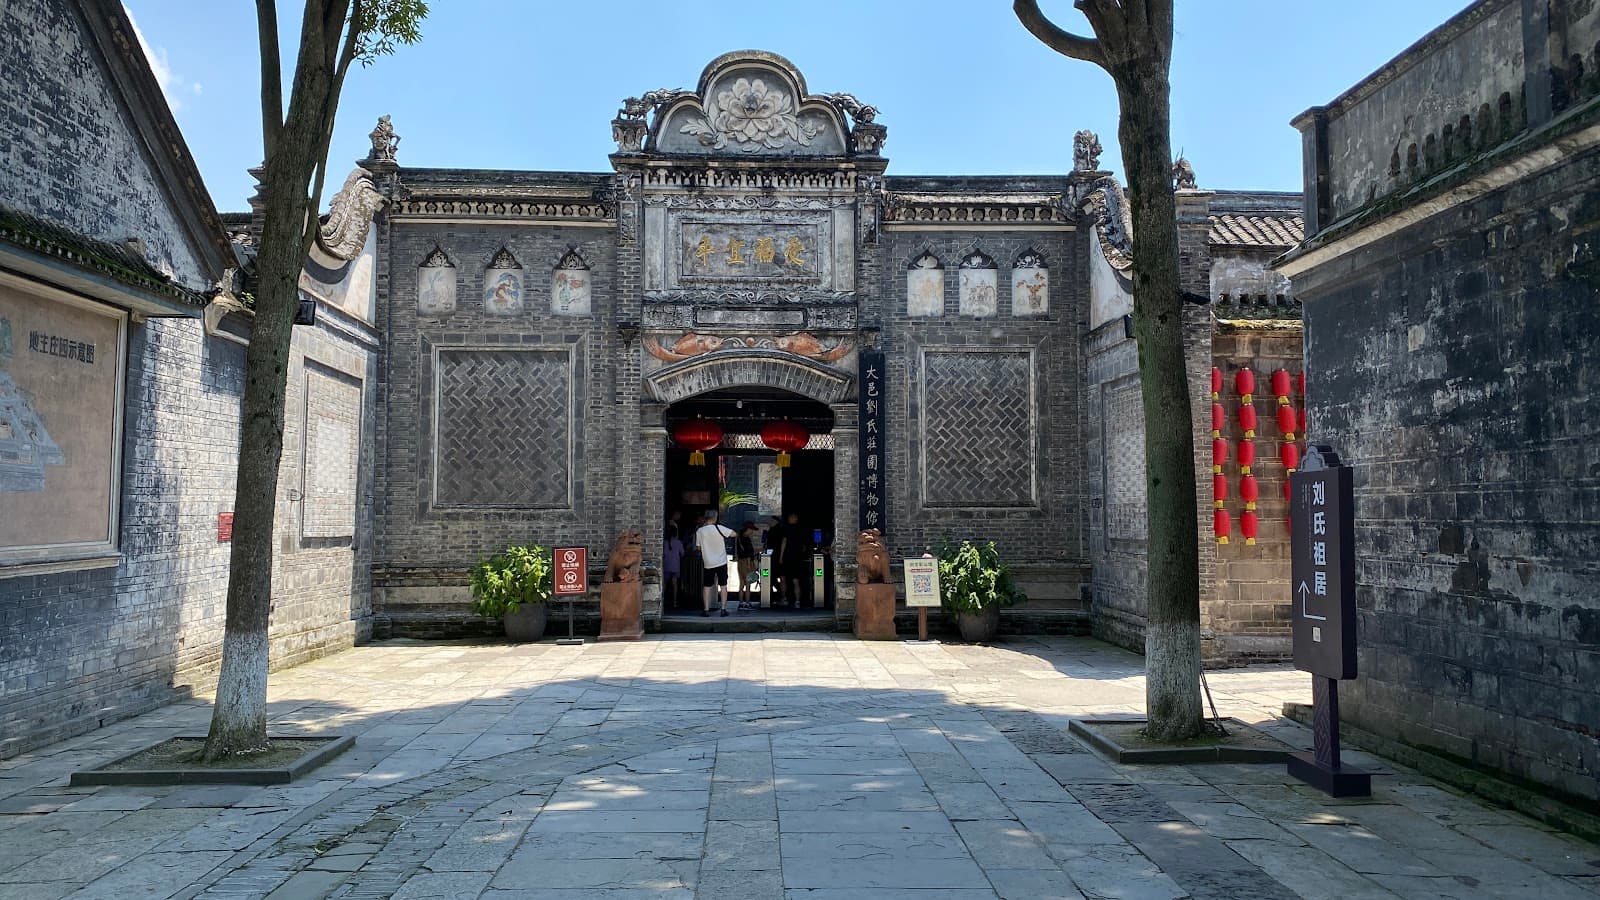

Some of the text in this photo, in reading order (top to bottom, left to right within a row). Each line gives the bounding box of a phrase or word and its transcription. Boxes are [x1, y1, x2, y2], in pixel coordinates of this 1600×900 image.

[29, 330, 95, 364] 地主庄园示意图
[1312, 481, 1326, 596] 刘氏祖居
